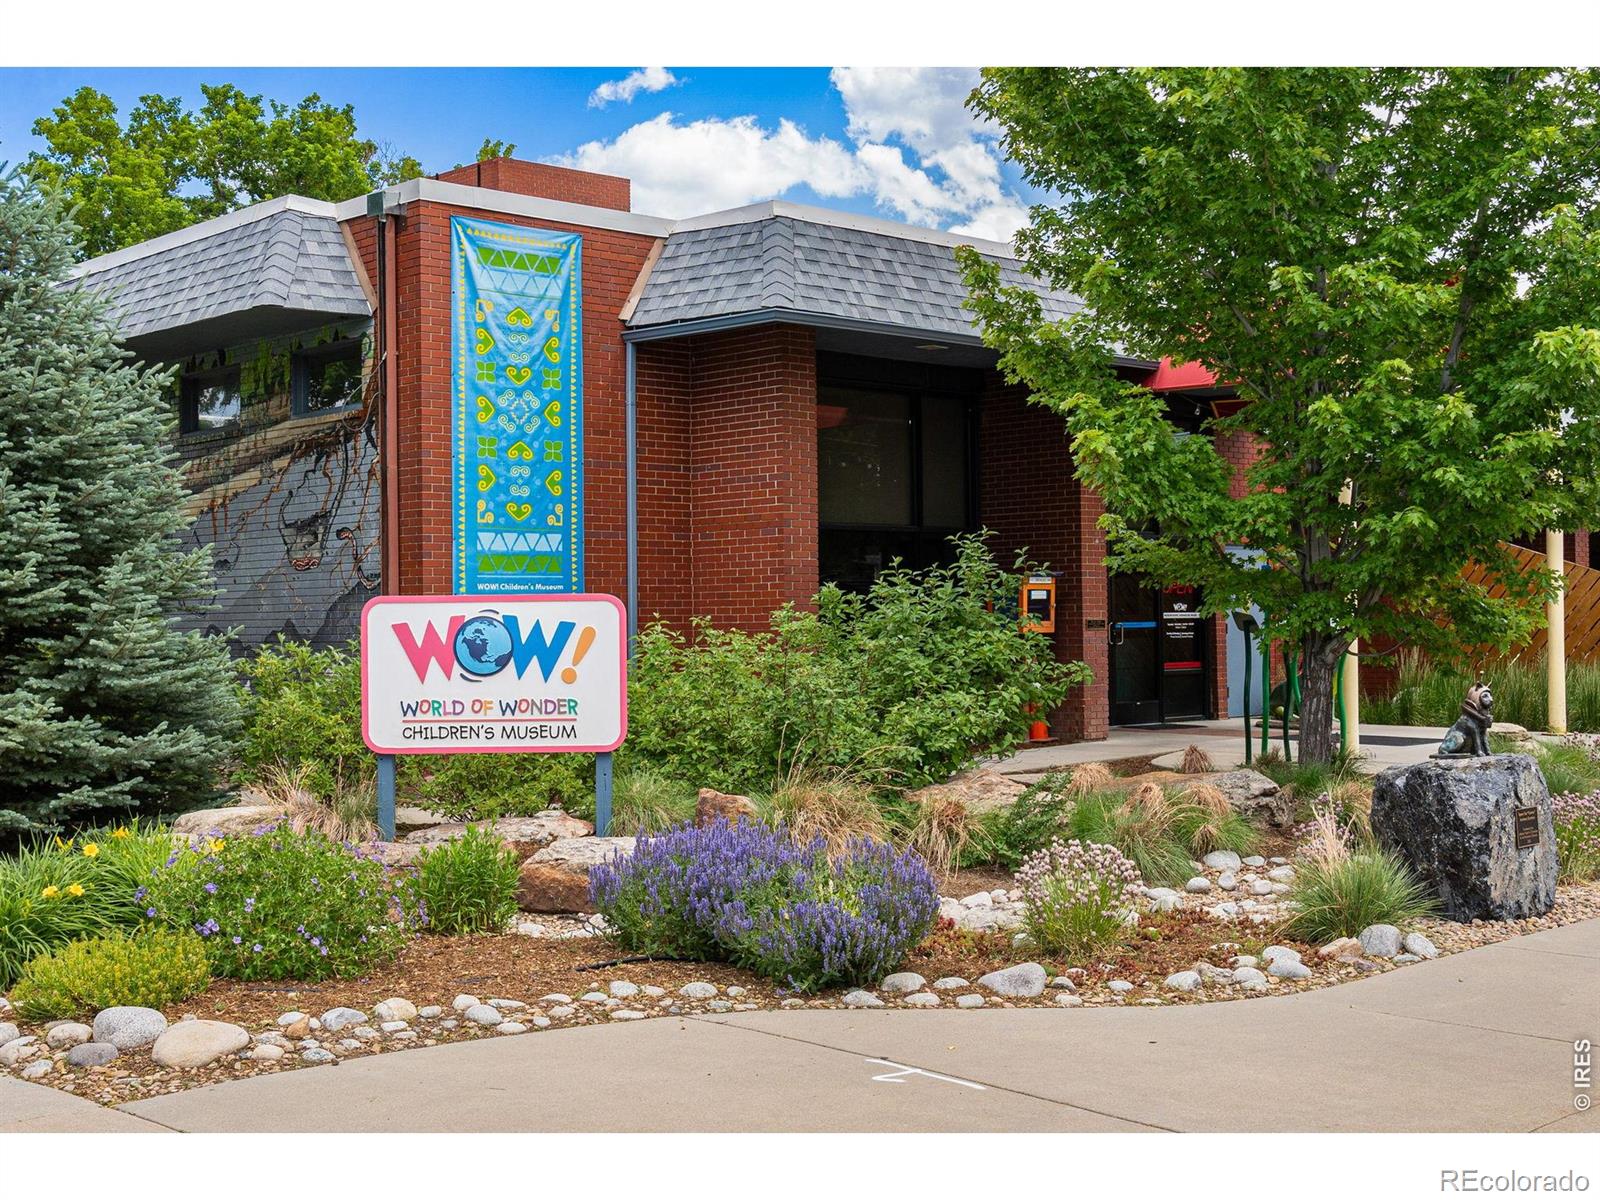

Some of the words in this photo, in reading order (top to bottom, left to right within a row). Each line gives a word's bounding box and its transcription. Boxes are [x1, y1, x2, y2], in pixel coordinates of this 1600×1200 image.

[477, 583, 499, 591] WOW!
[500, 583, 534, 591] Children's
[535, 583, 564, 591] Museum
[391, 614, 597, 684] WOW!
[400, 699, 464, 717] WORLD
[471, 699, 494, 716] OF
[499, 698, 578, 716] WONDER
[402, 724, 495, 740] CHILDREN'S
[501, 725, 577, 740] MUSEUM
